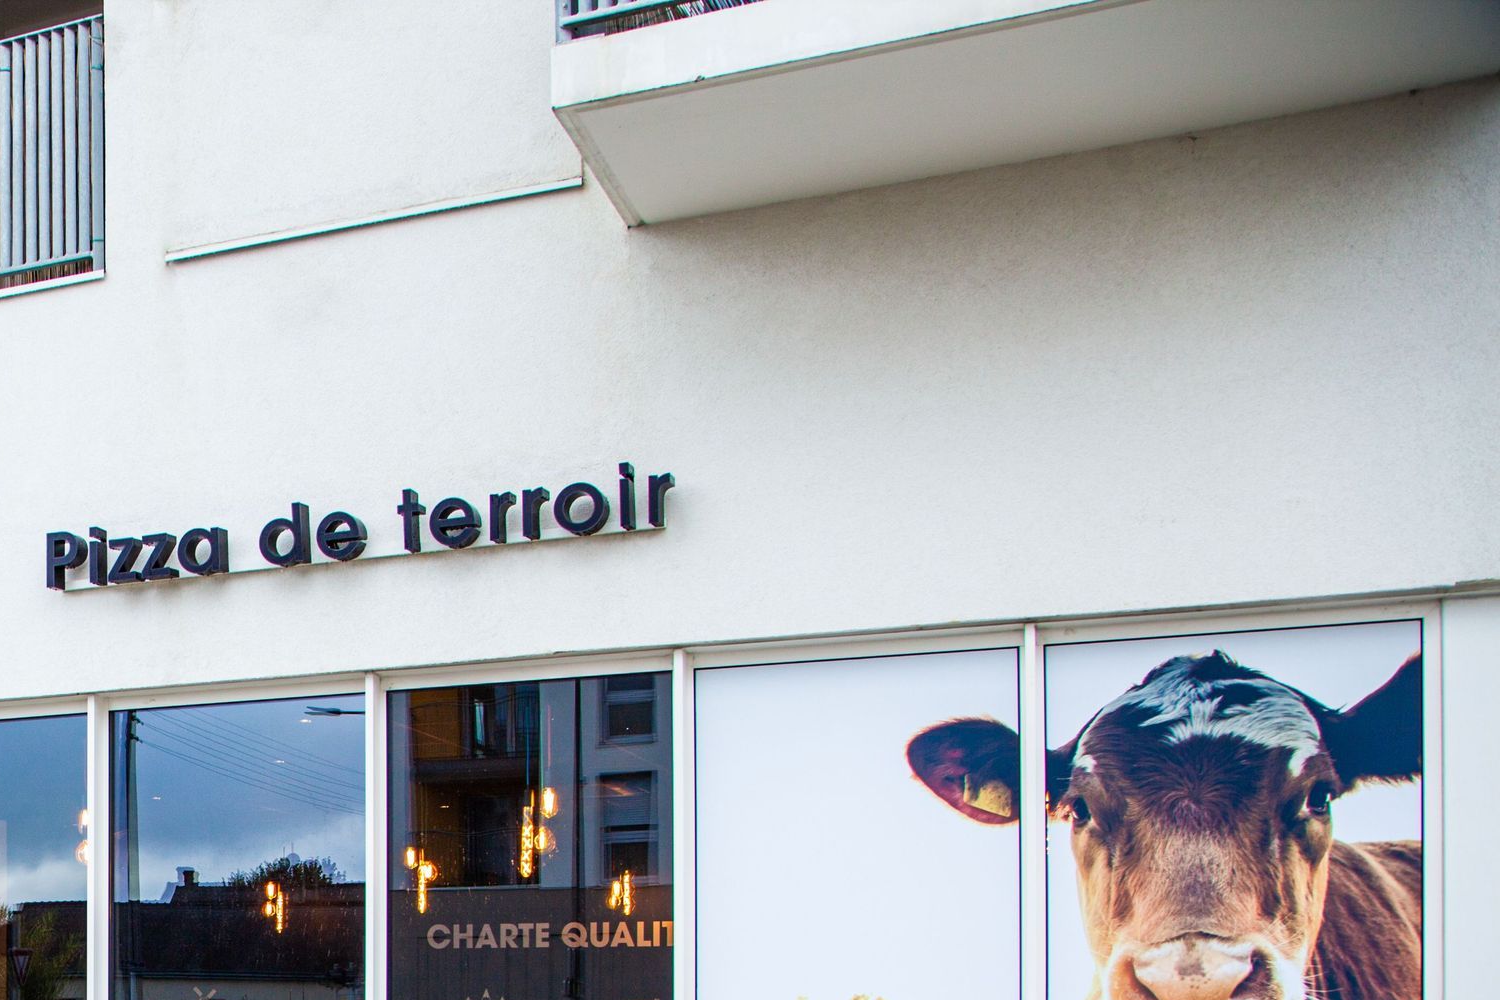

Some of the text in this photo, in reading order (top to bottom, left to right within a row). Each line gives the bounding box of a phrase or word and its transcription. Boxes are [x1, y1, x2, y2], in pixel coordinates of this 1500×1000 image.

[46, 462, 675, 591] Pizza de terroir
[426, 920, 674, 949] CHARTE QUALIT
